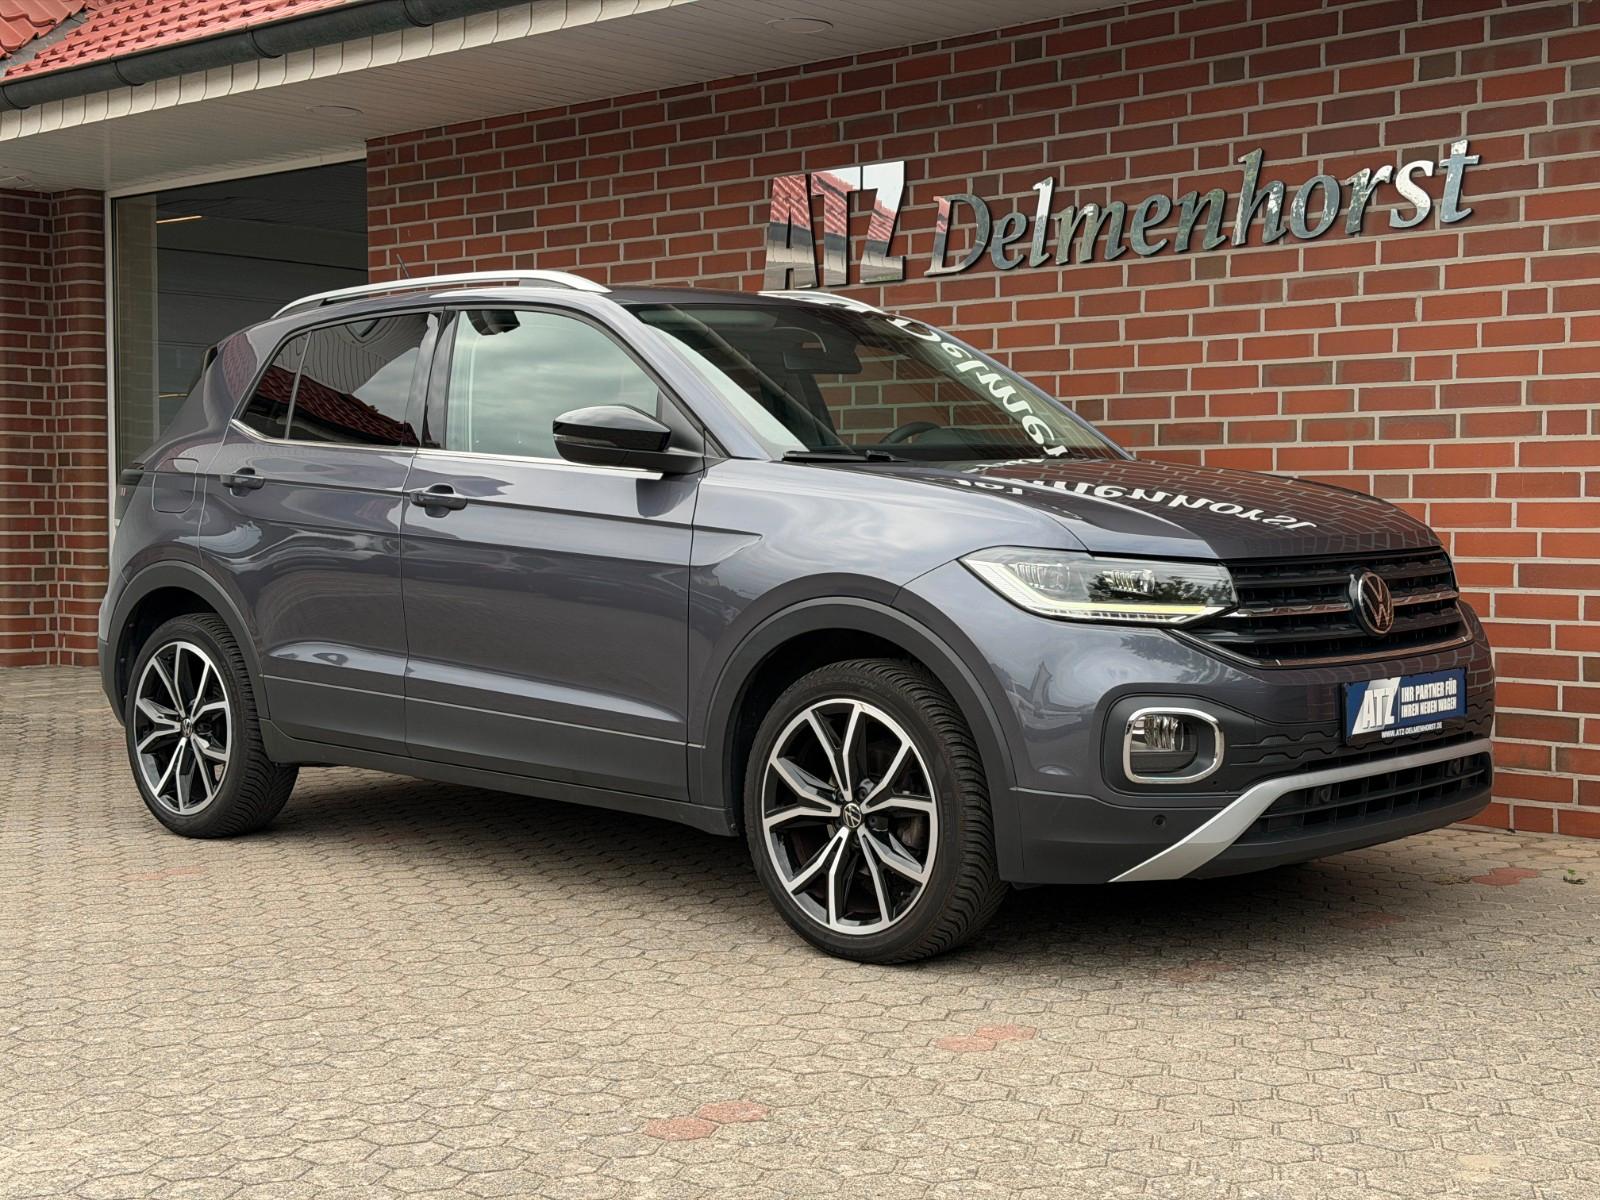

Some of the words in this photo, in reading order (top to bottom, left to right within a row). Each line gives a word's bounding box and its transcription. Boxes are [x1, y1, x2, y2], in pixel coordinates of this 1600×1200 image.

[762, 160, 906, 290] ATZ
[924, 139, 1480, 278] Delmenhorst
[1358, 571, 1394, 633] VW
[1361, 686, 1397, 728] ATZ
[1401, 686, 1414, 702] IHR
[1415, 681, 1444, 700] PARTNER
[1445, 677, 1457, 695] FÜR
[1401, 702, 1419, 718] IHREN
